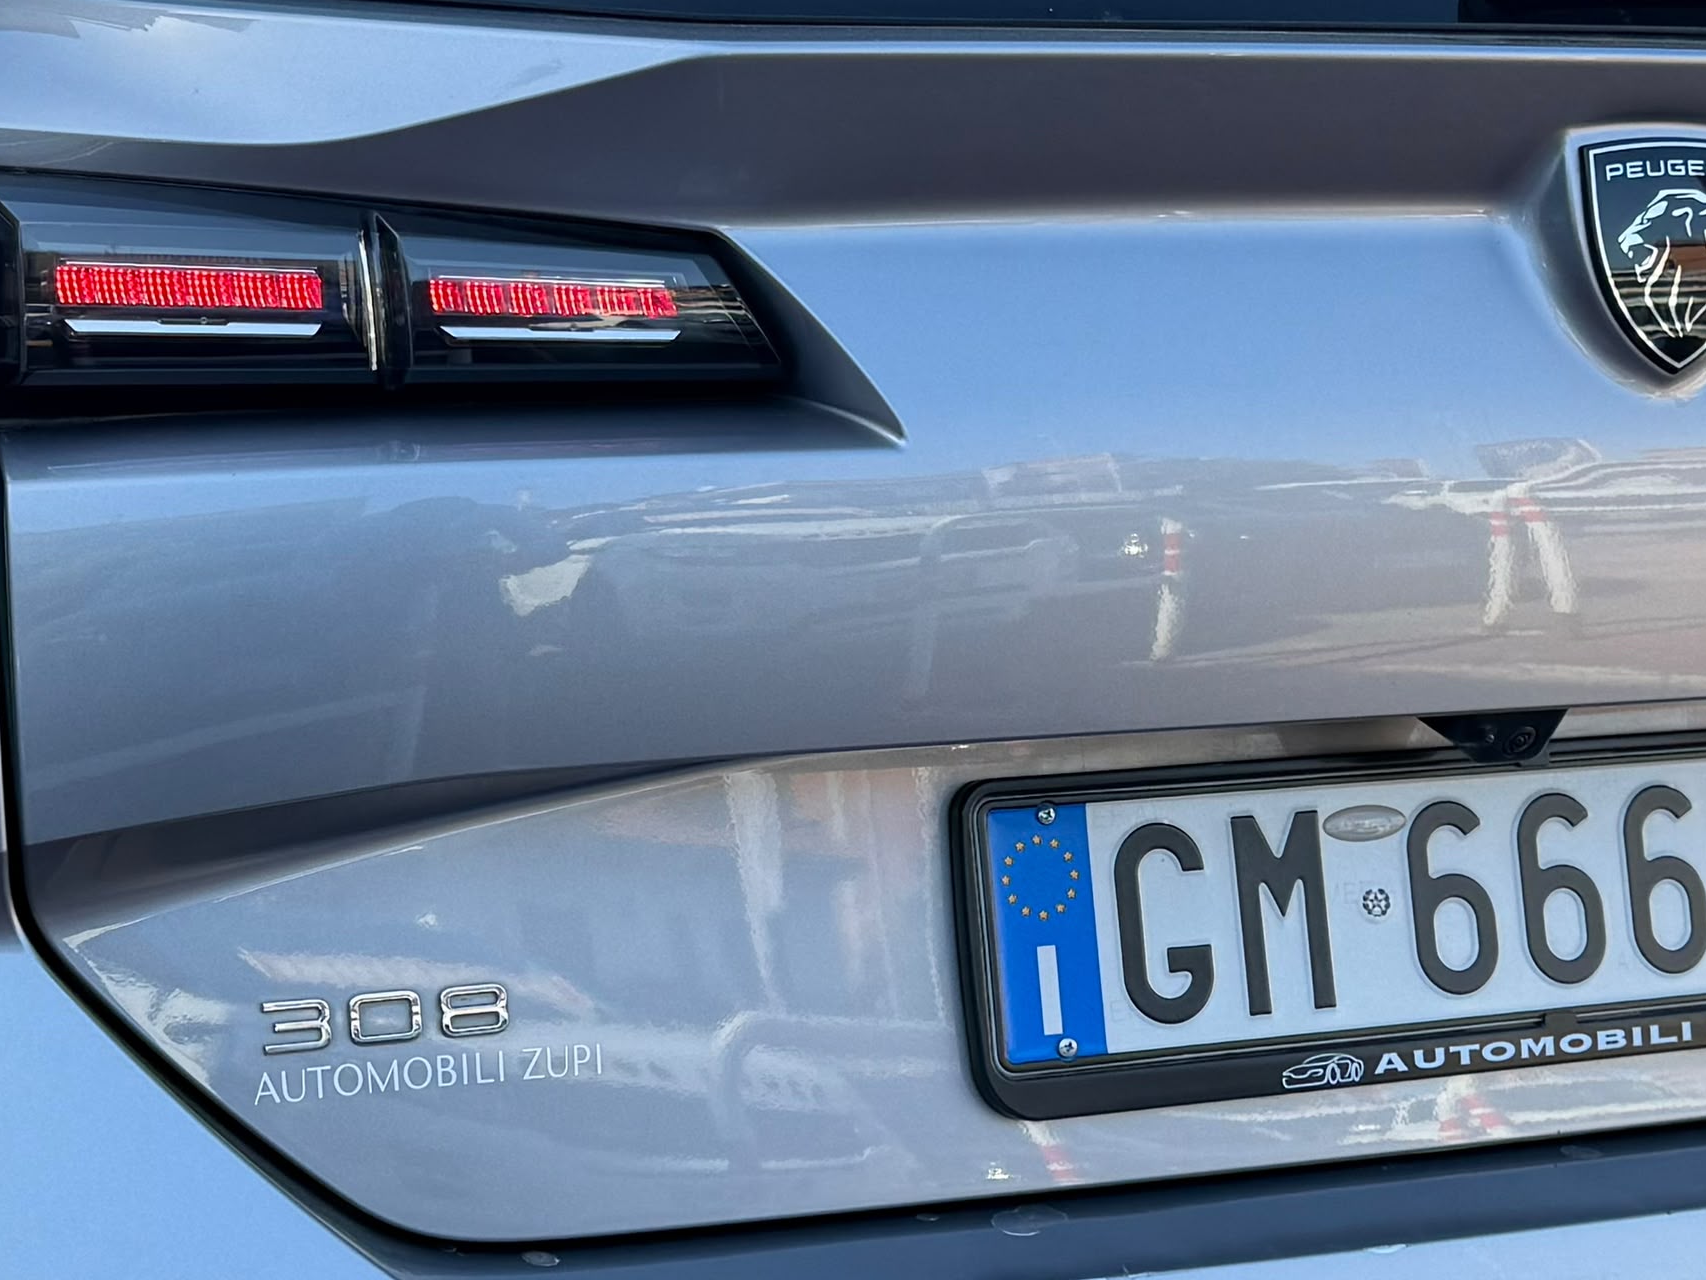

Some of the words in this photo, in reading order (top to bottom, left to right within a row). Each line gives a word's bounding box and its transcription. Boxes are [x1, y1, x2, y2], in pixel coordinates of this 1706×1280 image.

[260, 983, 510, 1056] 308
[1374, 1025, 1694, 1075] AUTOMOBILI
[254, 1050, 506, 1106] AUTOMOBILI
[522, 1043, 603, 1081] ZUPI
